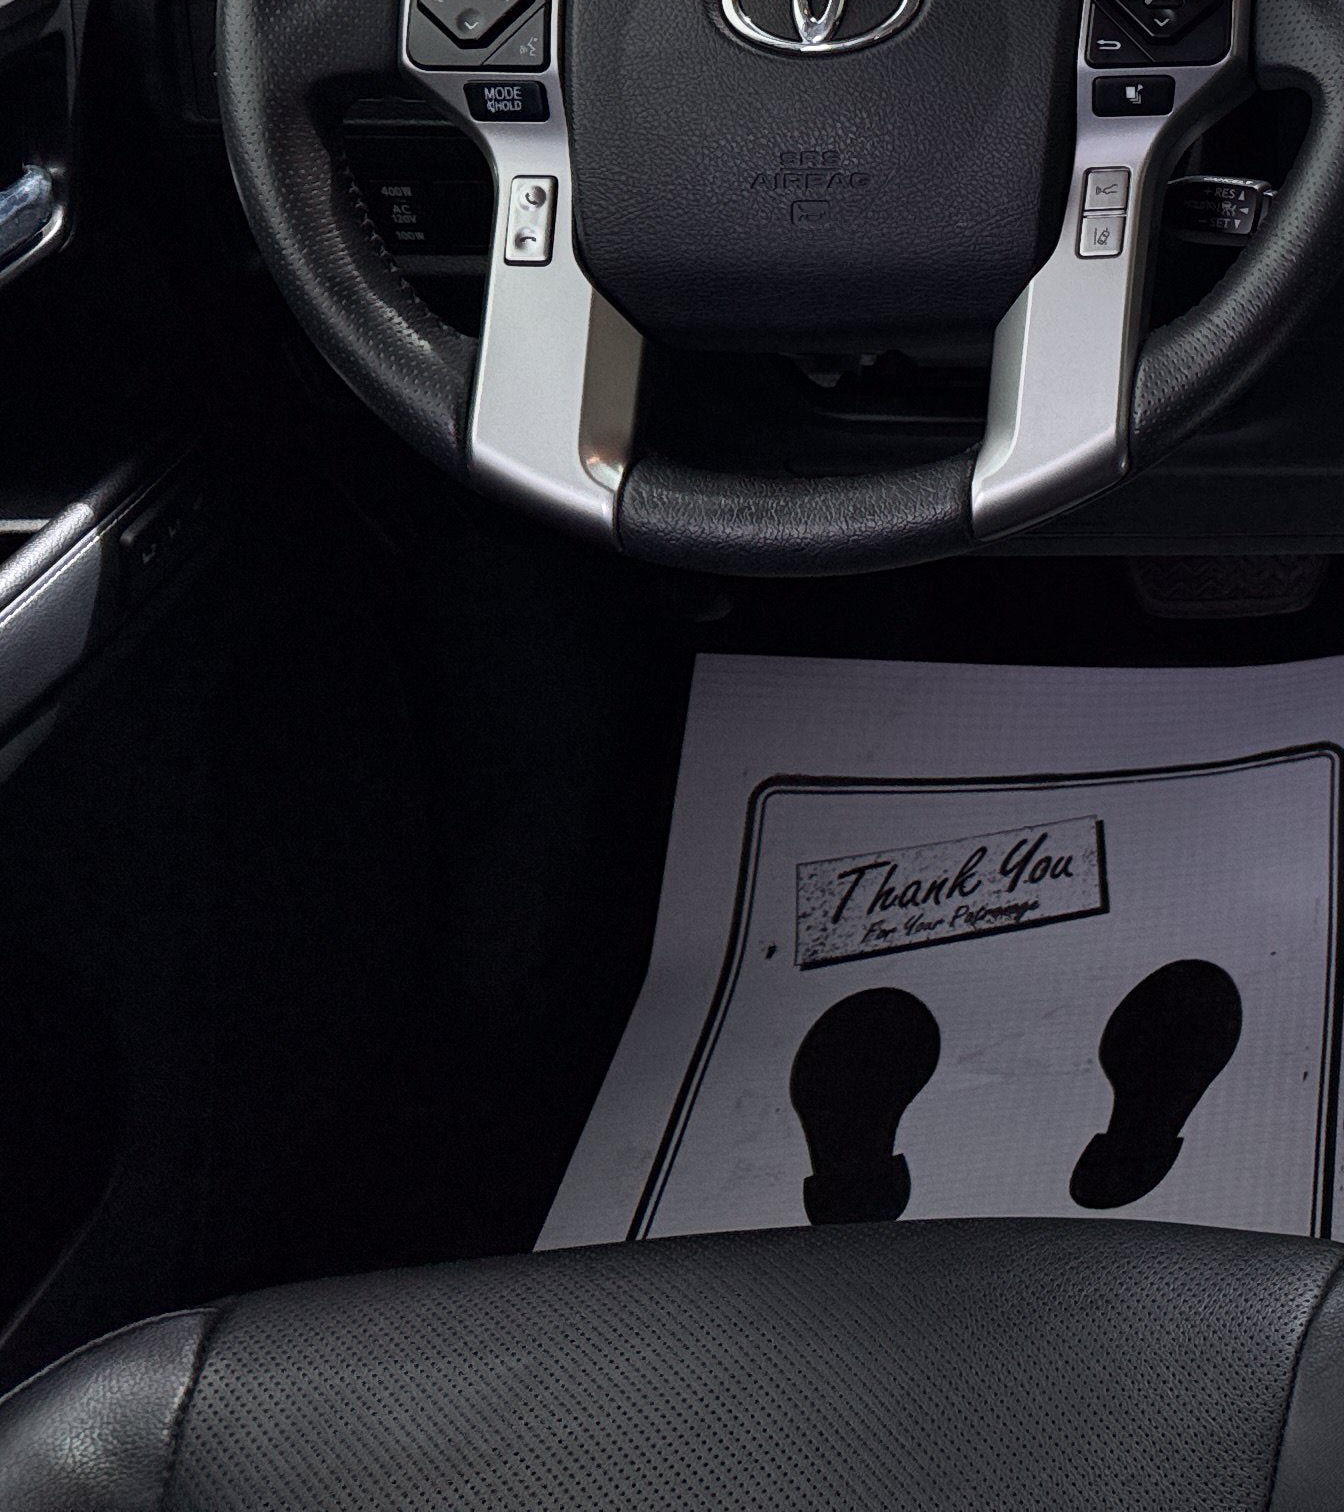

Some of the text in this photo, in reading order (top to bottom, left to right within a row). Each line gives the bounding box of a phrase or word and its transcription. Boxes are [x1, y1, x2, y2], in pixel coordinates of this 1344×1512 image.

[484, 86, 523, 100] MODE
[494, 100, 523, 112] HOLD
[779, 150, 842, 166] SRS
[750, 171, 872, 190] AIRBAG
[1214, 187, 1236, 199] RES
[392, 203, 413, 215] AC
[1210, 218, 1231, 229] SET
[830, 831, 1074, 925] Thank You
[862, 919, 899, 944] For
[903, 912, 948, 936] Your
